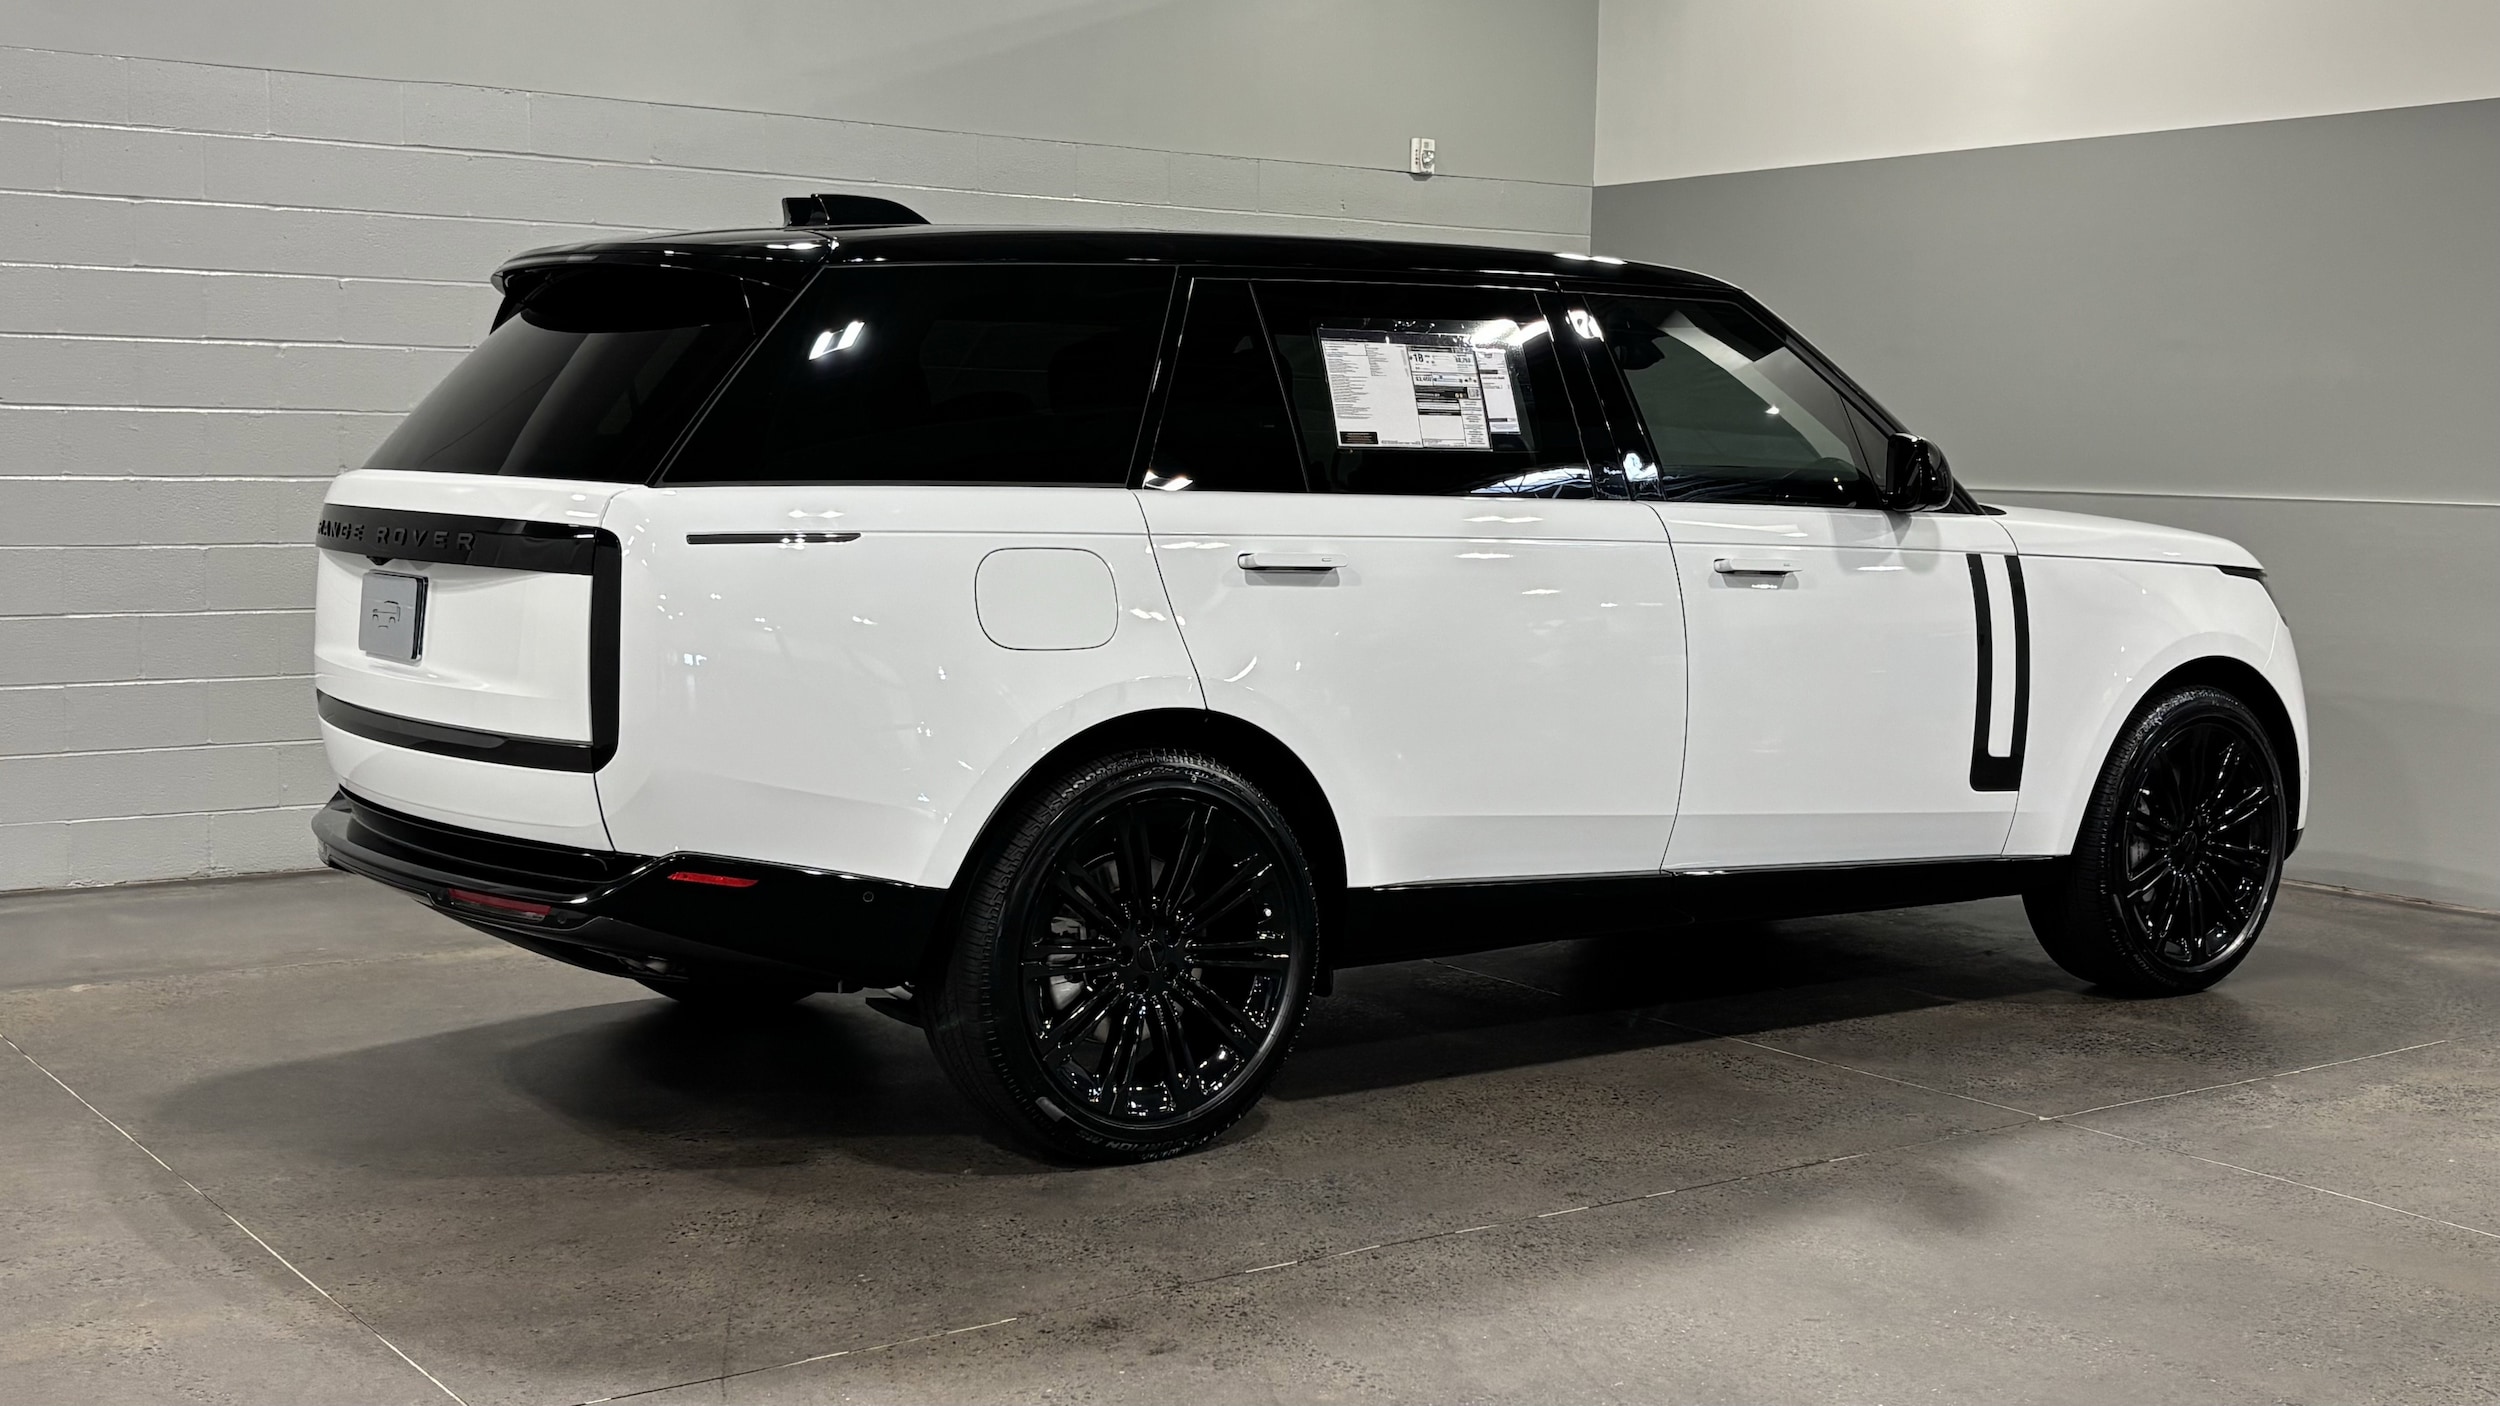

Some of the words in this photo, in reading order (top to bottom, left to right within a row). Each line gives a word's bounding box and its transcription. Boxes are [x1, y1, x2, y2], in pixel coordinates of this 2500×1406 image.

[1413, 353, 1424, 362] 18
[318, 520, 364, 541] RANGE
[376, 526, 476, 551] ROVER
